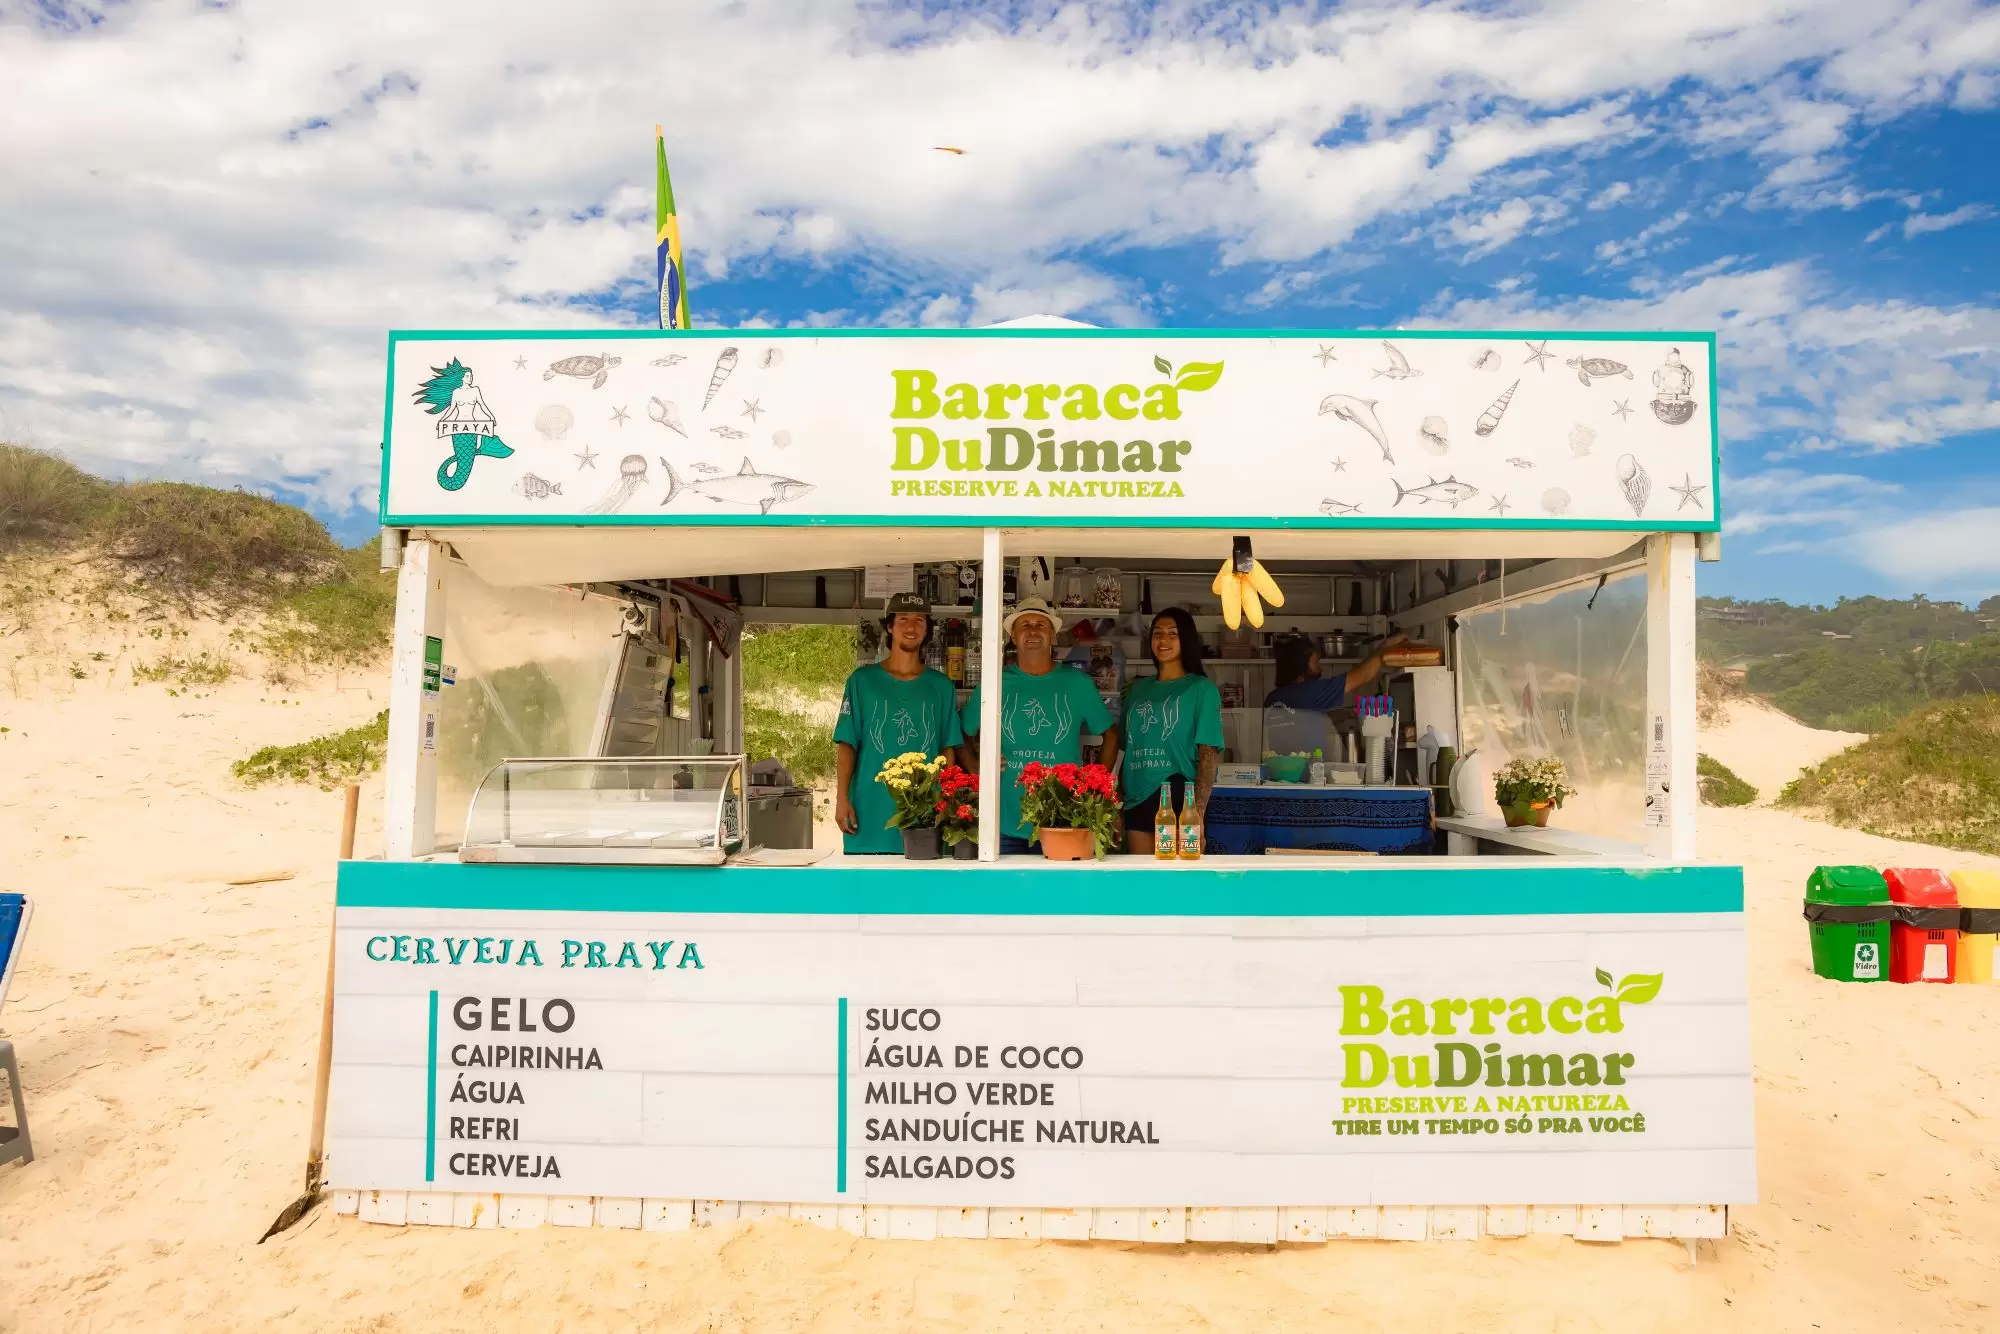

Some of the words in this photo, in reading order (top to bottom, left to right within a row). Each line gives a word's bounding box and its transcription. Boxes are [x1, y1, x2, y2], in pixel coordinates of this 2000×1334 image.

[890, 369, 1182, 420] Barraca
[442, 424, 490, 434] PRAYA
[890, 426, 1192, 472] DuDimar
[890, 479, 1018, 497] PRESERVE
[1024, 480, 1043, 497] A
[1048, 480, 1186, 498] NATUREZA
[1012, 750, 1056, 760] PROTEJA
[1142, 759, 1172, 768] PRAYA
[366, 935, 545, 966] CERVEJA
[560, 939, 705, 970] PRAYA
[453, 996, 576, 1033] GELO
[865, 1008, 941, 1031] SUCO
[1338, 985, 1625, 1036] Barraca
[451, 1043, 604, 1070] CAIPIRINHA
[864, 1037, 944, 1068] ÁGUA
[954, 1045, 989, 1068] DE
[1000, 1046, 1084, 1069] COCO
[1340, 1042, 1635, 1088] DuDimar
[449, 1072, 526, 1104] ÁGUA
[864, 1081, 957, 1105] MILHO
[966, 1082, 1054, 1106] VERDE
[1341, 1095, 1467, 1114] PRESERVE
[1474, 1095, 1491, 1113] A
[1497, 1094, 1630, 1113] NATUREZA
[450, 1116, 519, 1141] REFRI
[865, 1111, 1025, 1143] SANDUÍCHE
[1036, 1120, 1160, 1144] NATURAL
[1332, 1119, 1382, 1135] TIRE
[1387, 1118, 1420, 1135] UM
[1424, 1118, 1499, 1135] TEMPO
[1504, 1112, 1533, 1134] SÓ
[1538, 1116, 1583, 1134] PRA
[1590, 1112, 1646, 1133] VOCÊ
[449, 1153, 562, 1179] CERVEJA
[865, 1155, 1016, 1179] SALGADOS
